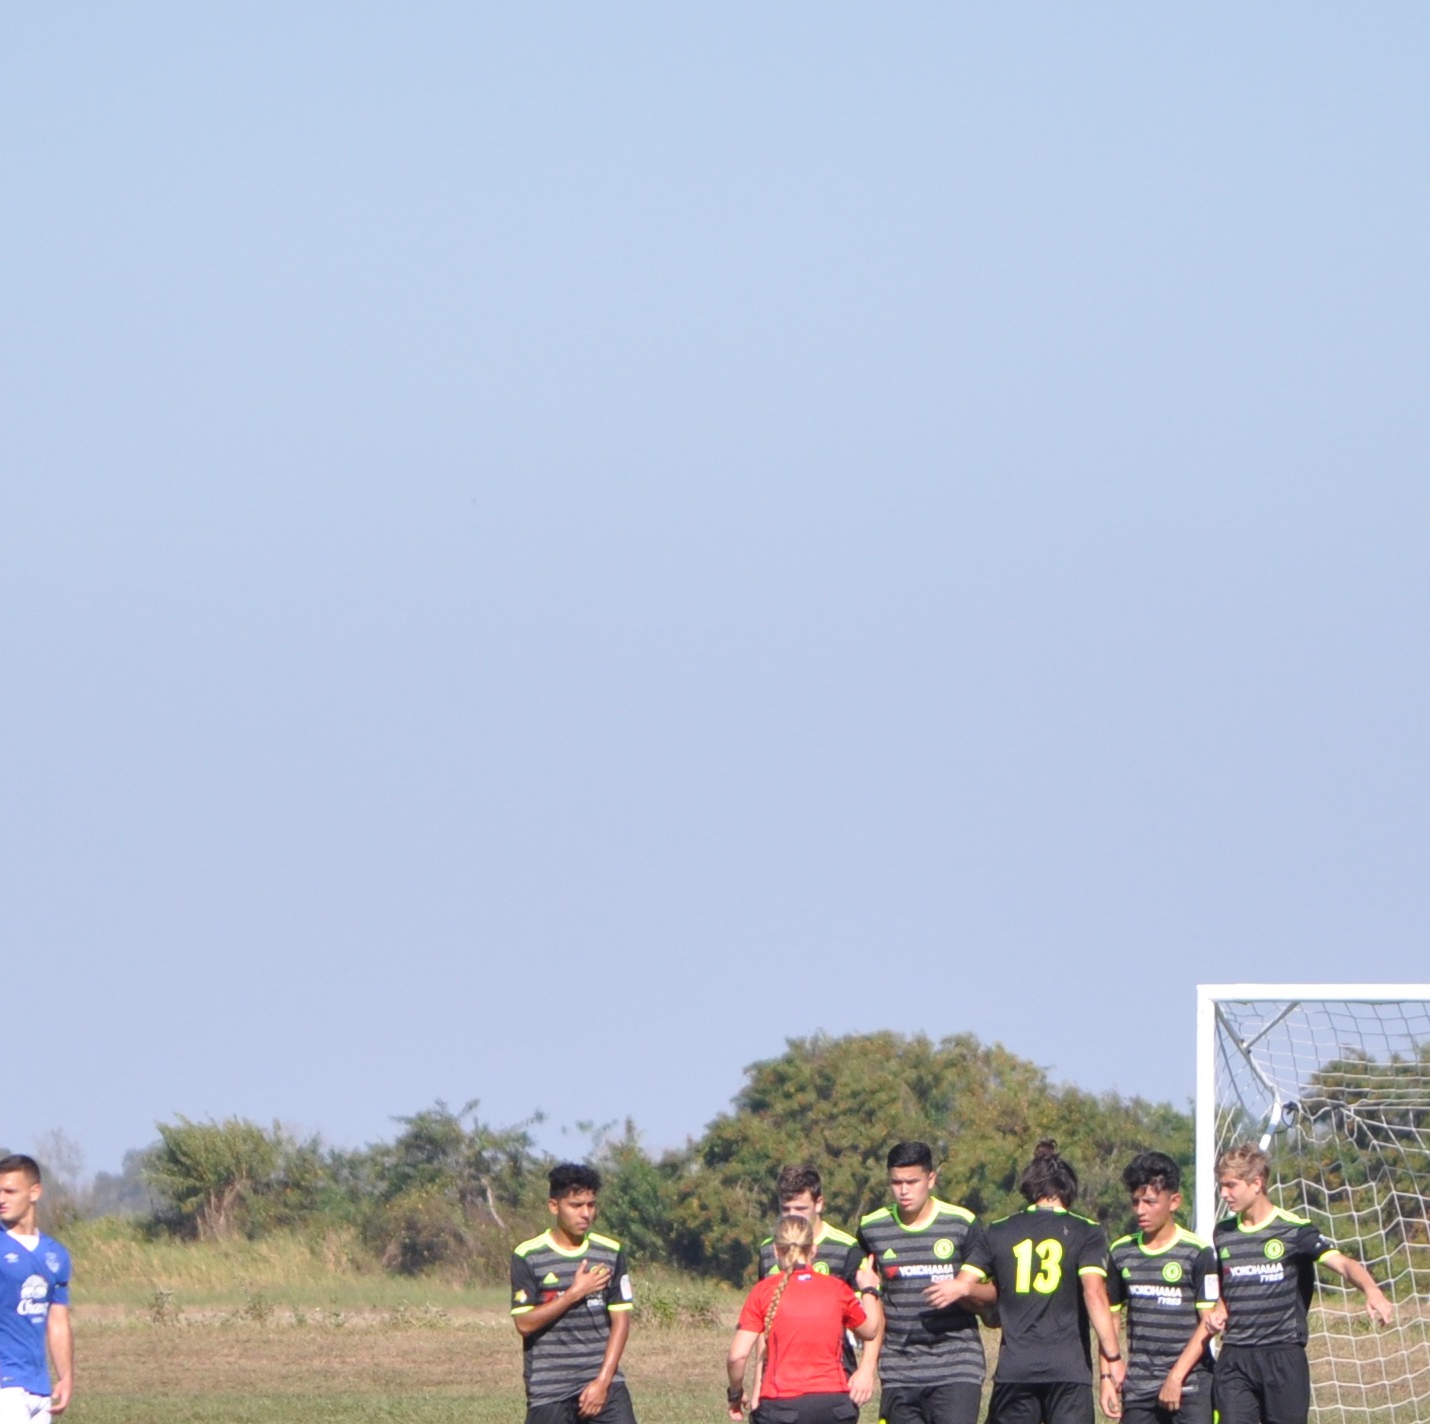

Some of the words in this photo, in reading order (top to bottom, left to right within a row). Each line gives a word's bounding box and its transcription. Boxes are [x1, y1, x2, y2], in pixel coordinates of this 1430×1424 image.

[898, 1263, 954, 1277] YOKOHAMA
[1013, 1238, 1062, 1294] 13
[1229, 1262, 1284, 1277] YOKOHAMA
[1129, 1284, 1182, 1298] YOKOHAMA
